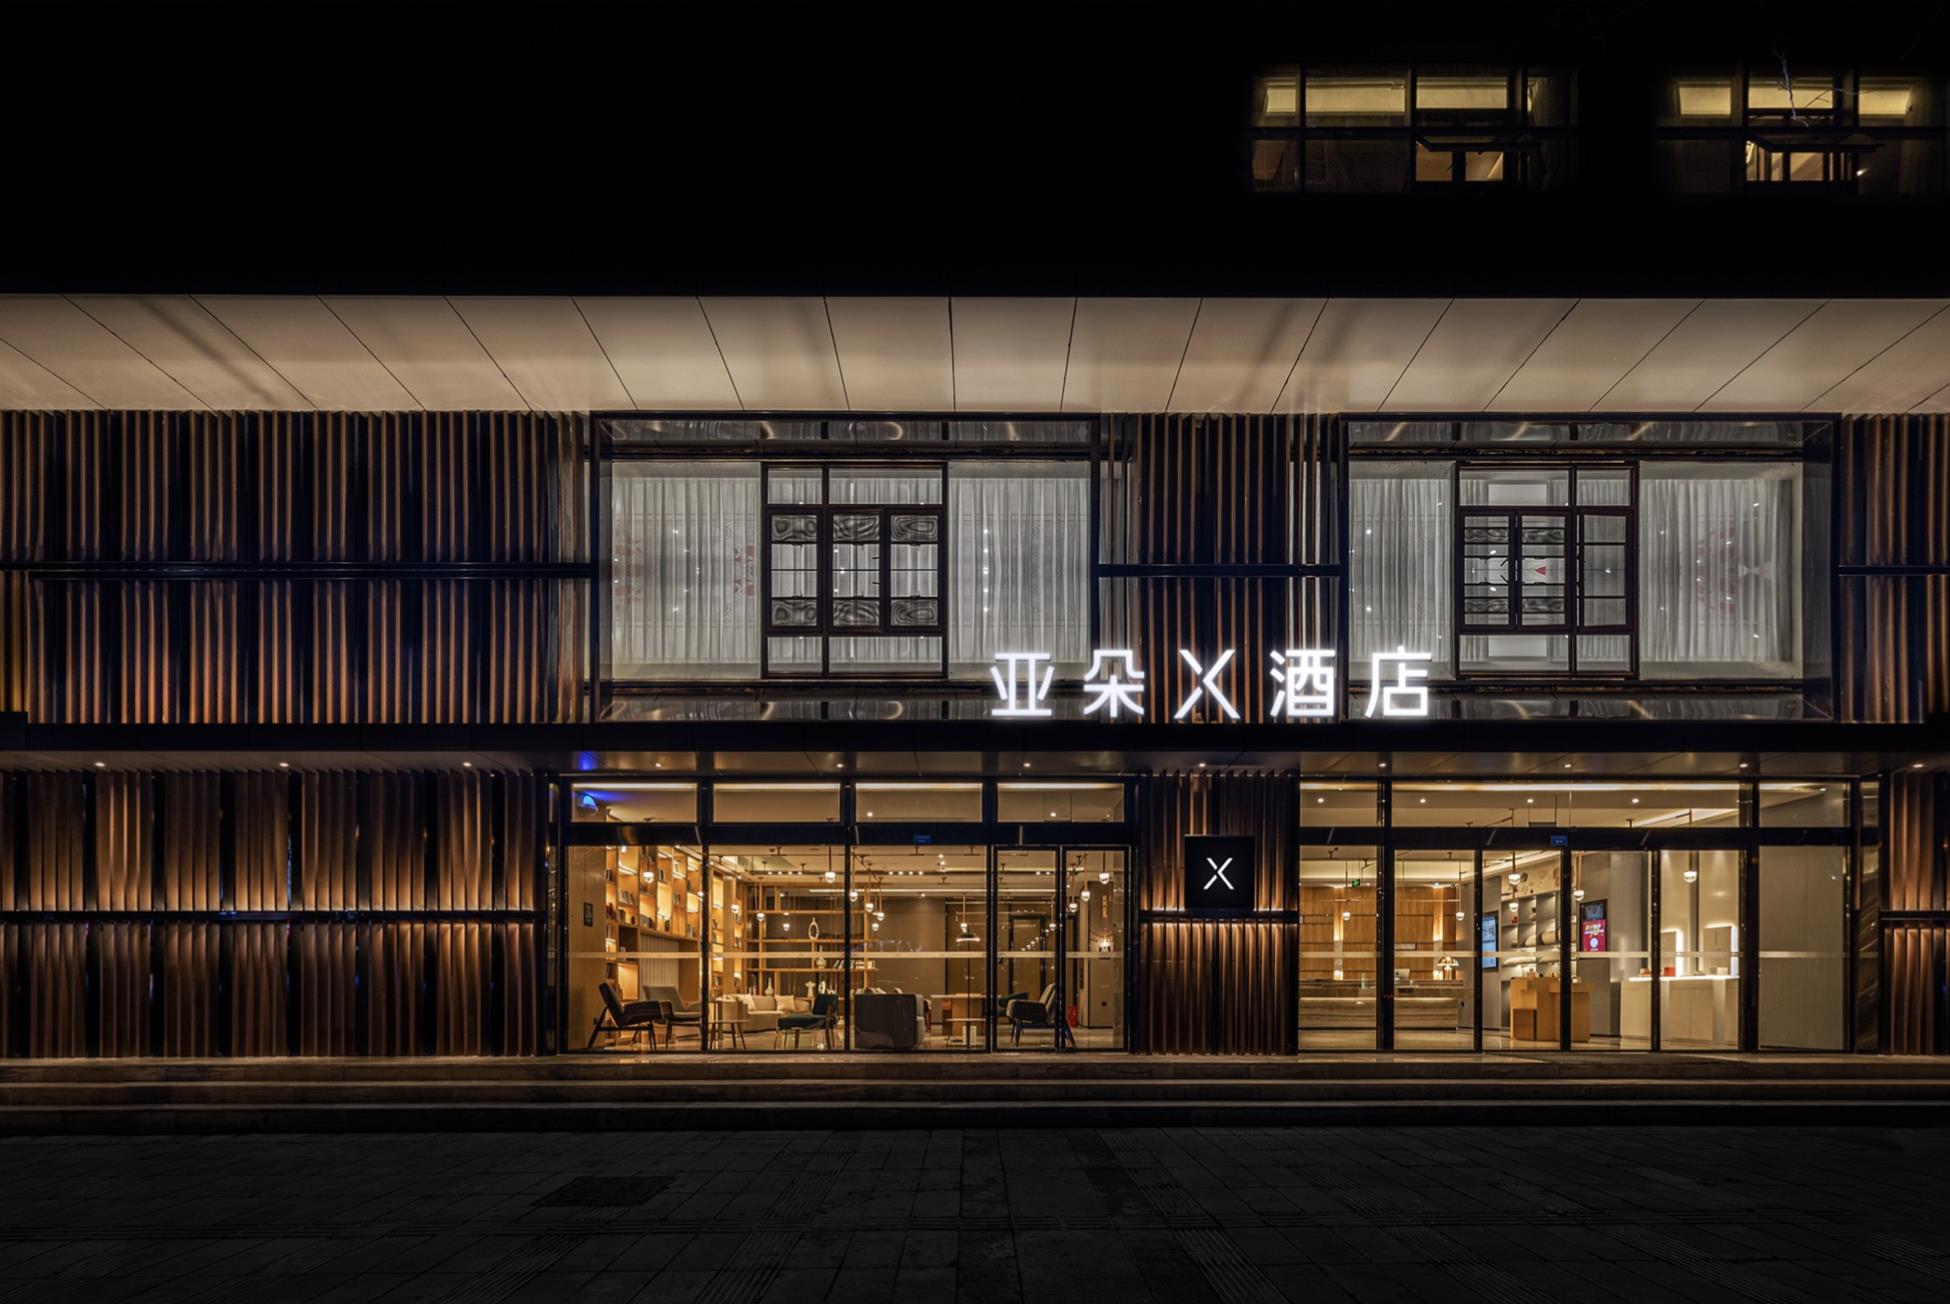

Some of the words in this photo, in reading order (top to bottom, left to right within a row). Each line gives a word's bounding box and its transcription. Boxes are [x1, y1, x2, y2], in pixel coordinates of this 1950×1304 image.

[989, 645, 1433, 719] 亚朵X酒店
[1203, 857, 1235, 890] X
